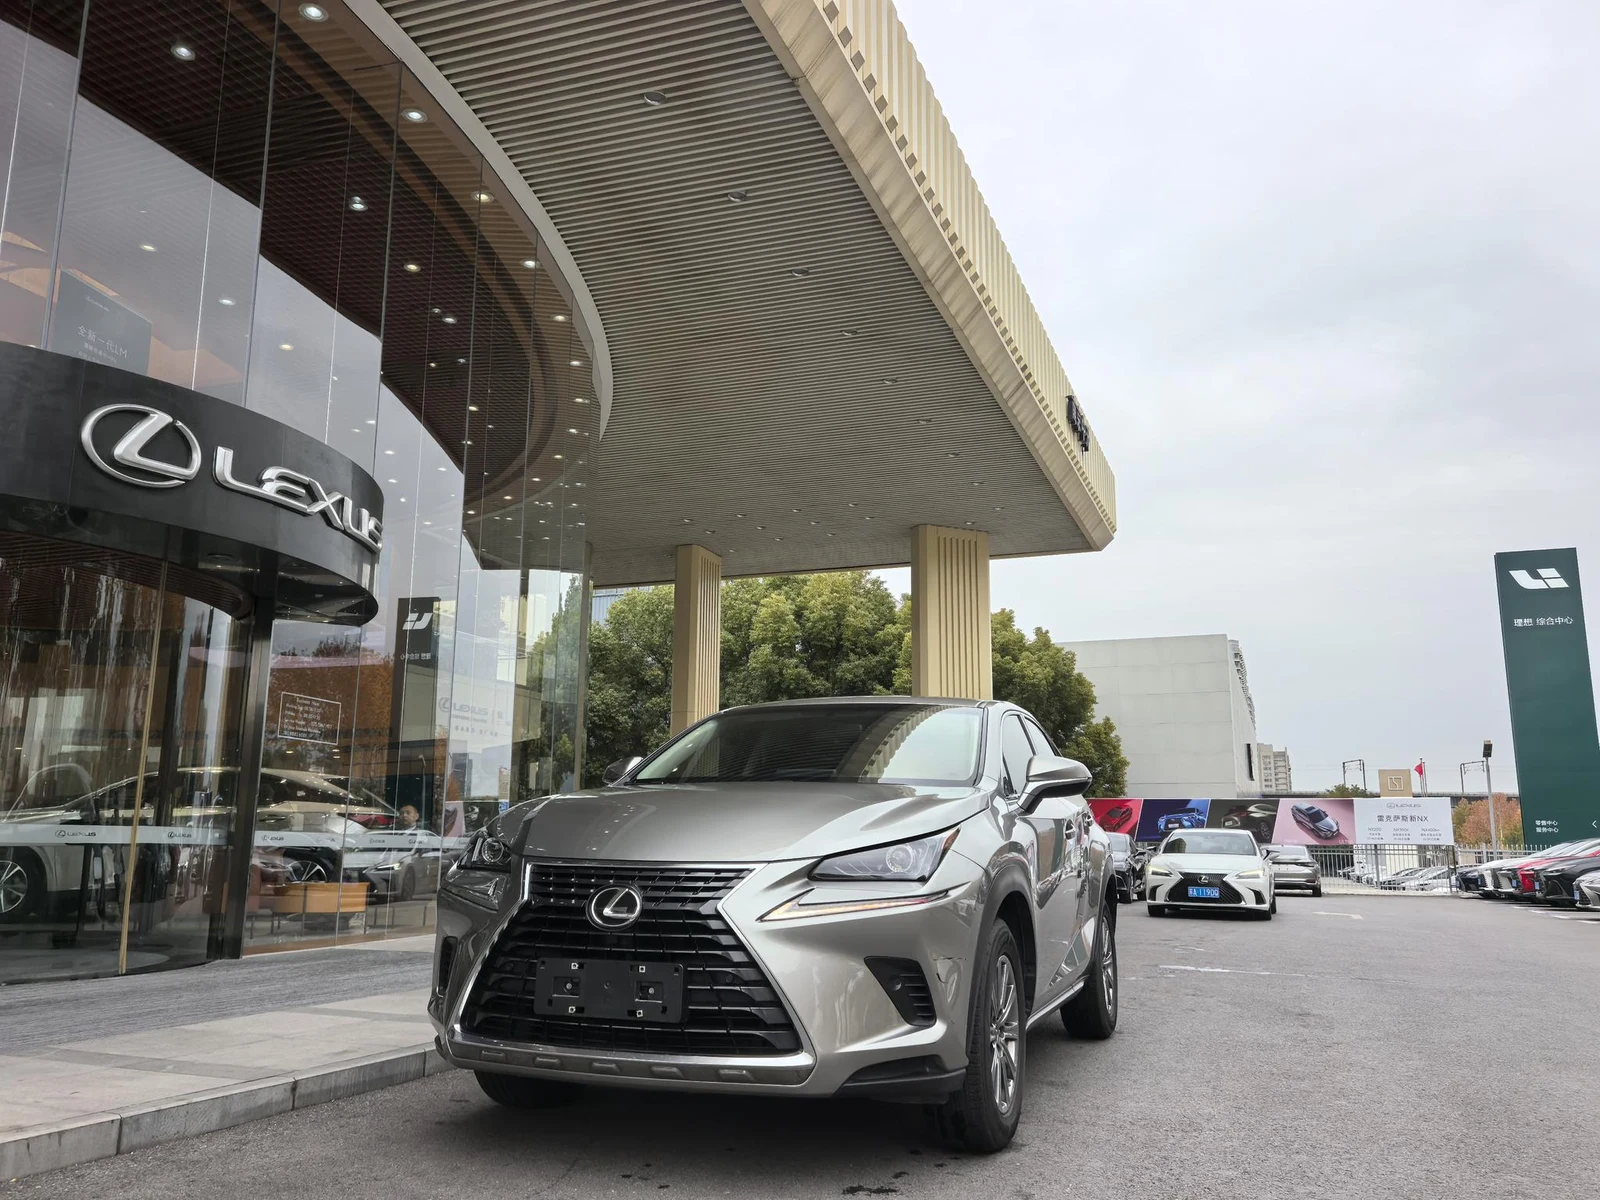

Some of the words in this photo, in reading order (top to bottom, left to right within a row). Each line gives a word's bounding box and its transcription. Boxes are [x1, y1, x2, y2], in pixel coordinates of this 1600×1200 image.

[77, 325, 128, 359] 全新一代LM
[212, 445, 384, 554] LEXUS
[1513, 618, 1534, 627] 理想
[1536, 616, 1573, 626] 综合中心
[1377, 814, 1429, 822] 雷克萨斯新NX
